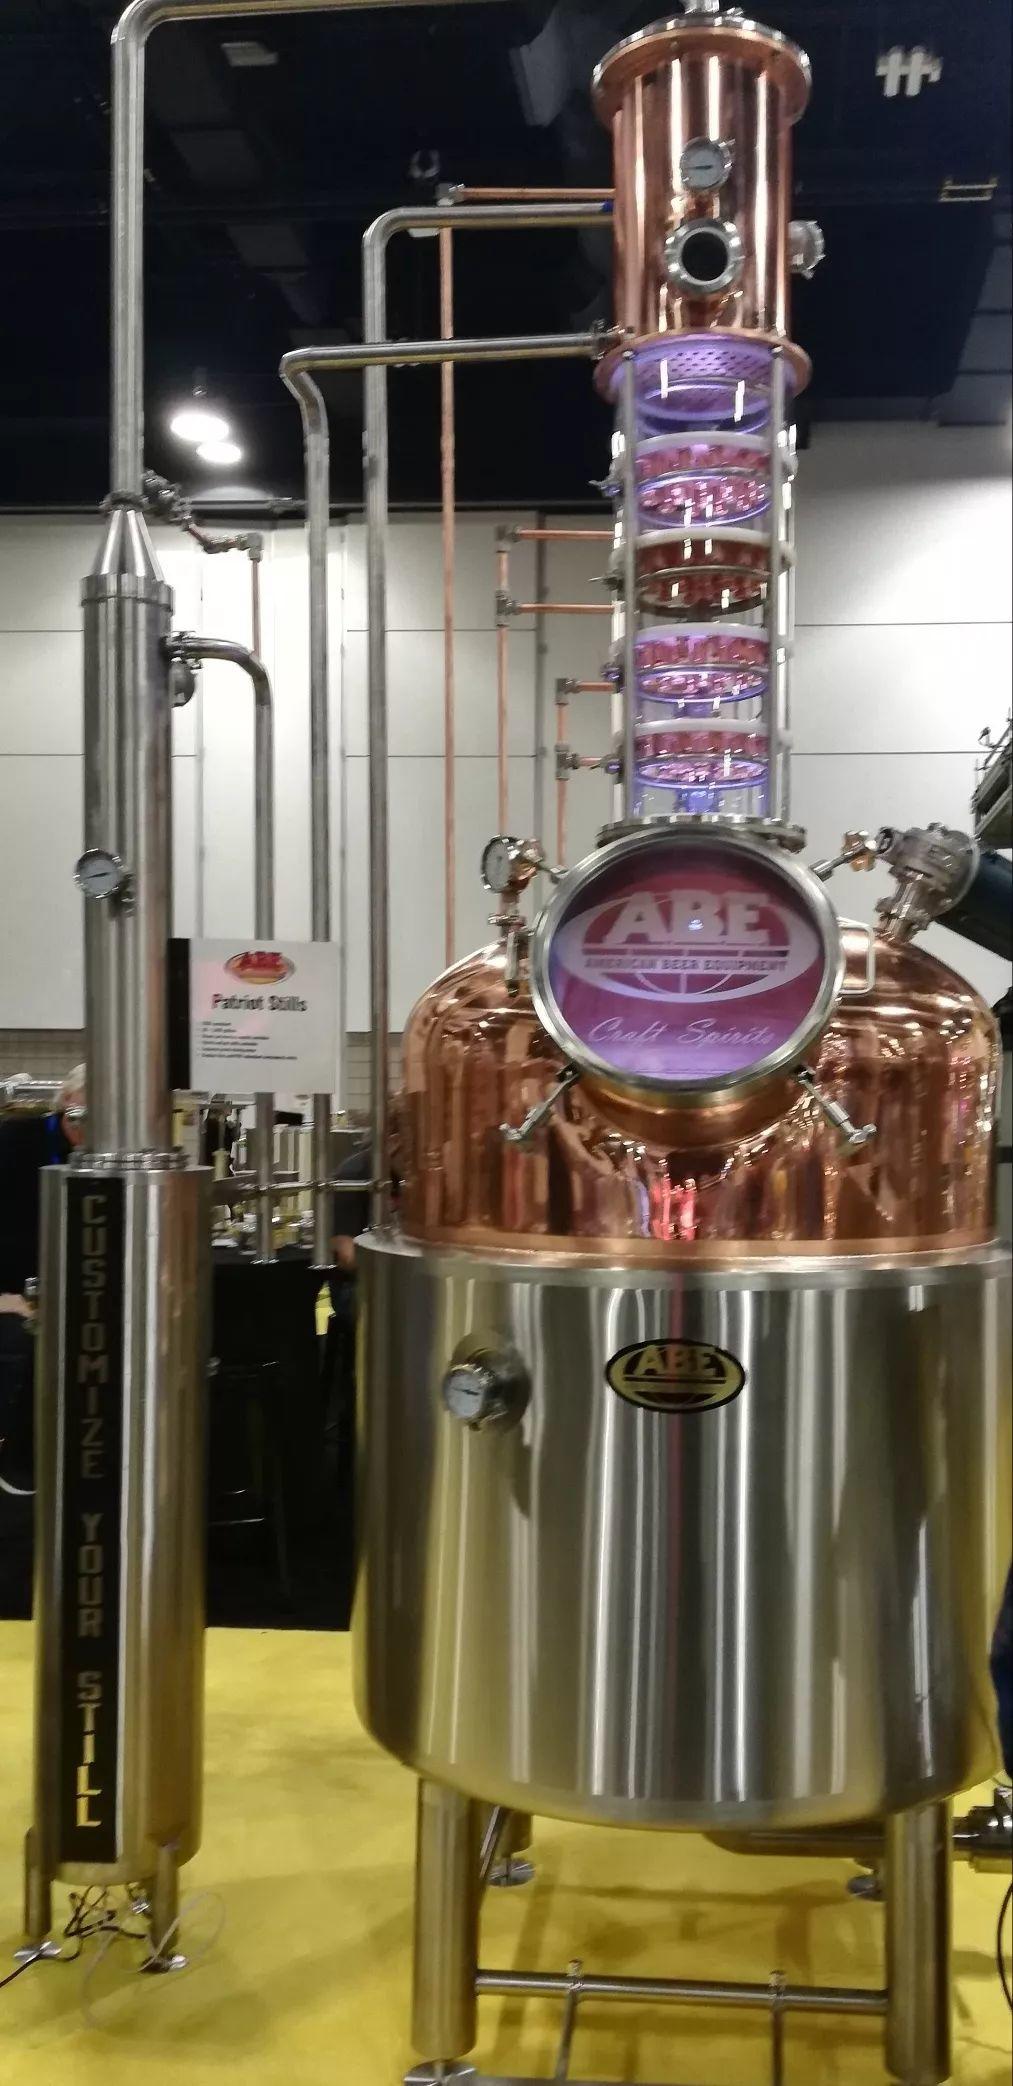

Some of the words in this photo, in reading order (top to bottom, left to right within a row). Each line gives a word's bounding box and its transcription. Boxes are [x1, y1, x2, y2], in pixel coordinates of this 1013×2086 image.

[604, 890, 768, 945] ABE
[585, 957, 658, 969] AMERICAN
[661, 958, 699, 970] BEER
[703, 959, 787, 972] EQUIPMENT
[588, 1017, 667, 1047] Craft
[678, 1018, 774, 1049] Spirits
[78, 1195, 108, 1478] CUSTOMIZE
[633, 1345, 717, 1376] ABE
[77, 1513, 104, 1638] YOUR
[76, 1671, 102, 1827] STILL
